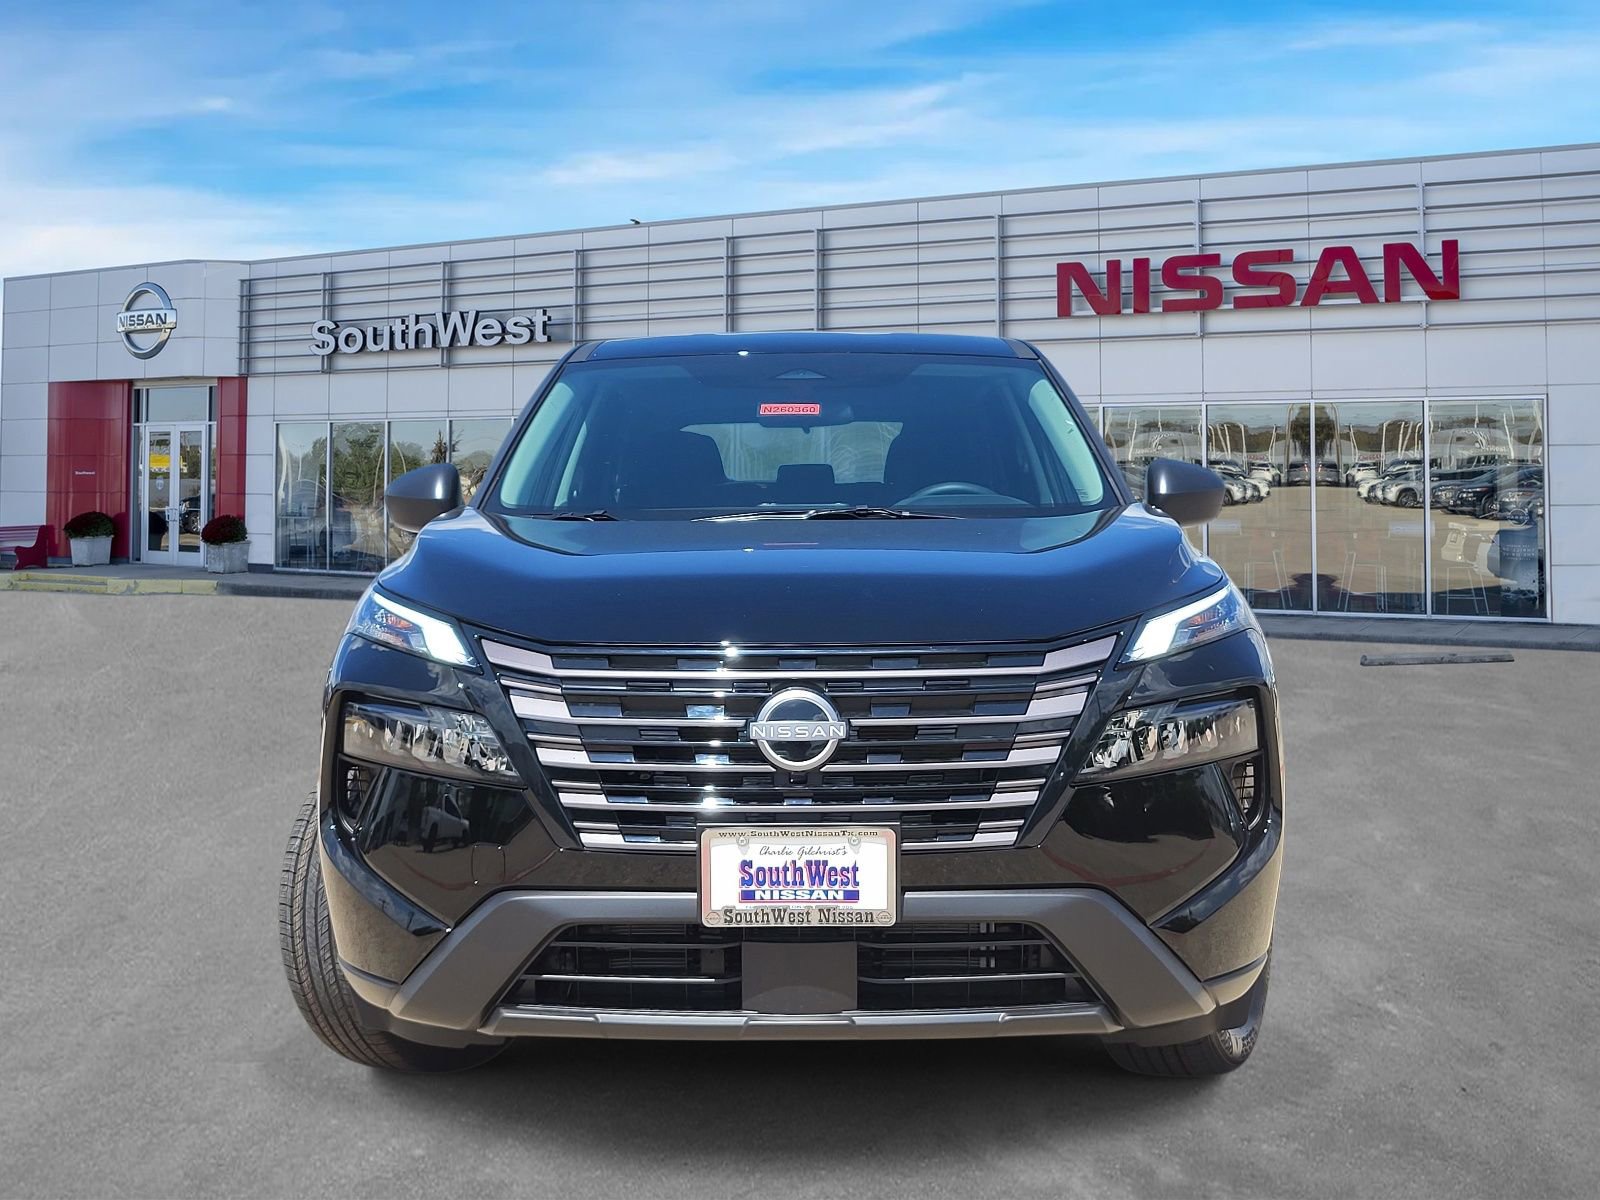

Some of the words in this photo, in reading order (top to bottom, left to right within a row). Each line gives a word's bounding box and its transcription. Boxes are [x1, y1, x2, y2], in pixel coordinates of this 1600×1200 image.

[1056, 239, 1461, 318] NISSAN
[118, 312, 168, 328] NISSAN
[309, 308, 552, 356] SouthWest
[751, 725, 845, 738] NISSAN
[718, 830, 878, 838] www.SouthWestNissanTx.com
[759, 845, 794, 856] Charlie
[797, 845, 848, 860] Gilchrist's
[739, 859, 860, 888] SouthWest
[754, 890, 844, 900] NISSAN
[723, 908, 811, 924] SouthWest
[818, 908, 875, 924] Nissan
